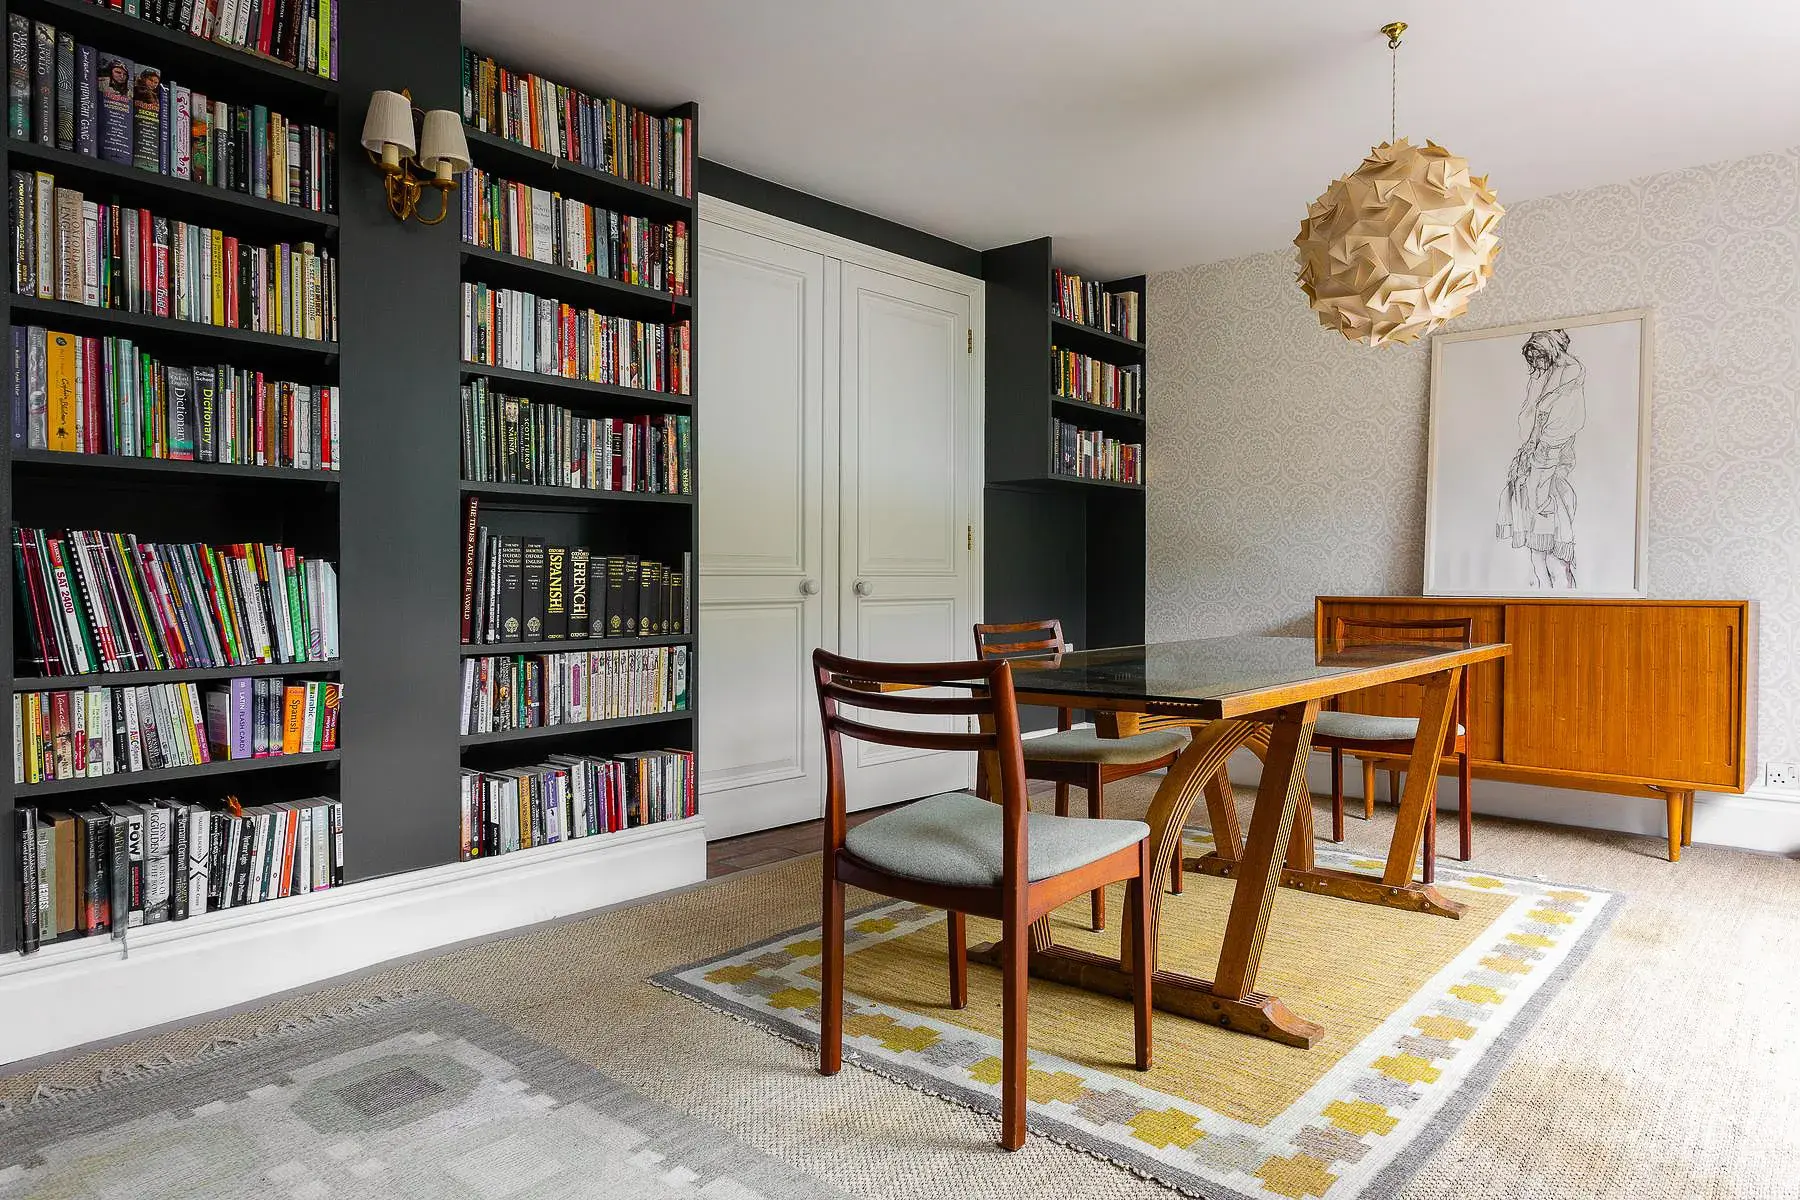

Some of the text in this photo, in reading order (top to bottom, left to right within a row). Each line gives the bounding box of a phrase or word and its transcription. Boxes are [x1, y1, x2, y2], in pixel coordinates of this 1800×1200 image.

[12, 31, 28, 71] MAGNUS CHASE
[38, 41, 46, 75] APOLLO
[80, 82, 91, 141] MIDNIGHT GANG
[71, 221, 81, 262] OXFORD
[309, 258, 315, 266] WE
[174, 387, 188, 444] Dictionary
[202, 388, 214, 444] Dictionary
[469, 500, 478, 518] THE
[468, 517, 476, 543] TIMES
[467, 566, 473, 577] OF
[549, 554, 563, 608] SPANISH
[57, 571, 74, 614] SAT 2400
[573, 561, 587, 614] FRENCH
[289, 699, 301, 733] Spanish
[308, 693, 317, 718] arabic
[129, 730, 138, 746] ABC
[238, 731, 246, 752] CARDS
[130, 822, 141, 856] POW
[150, 812, 160, 854] IGGULDEN
[159, 822, 167, 842] CONN
[177, 818, 187, 843] Bernard
[177, 844, 187, 871] Cornwell
[39, 883, 49, 910] HEROES
[151, 880, 159, 896] BOW
